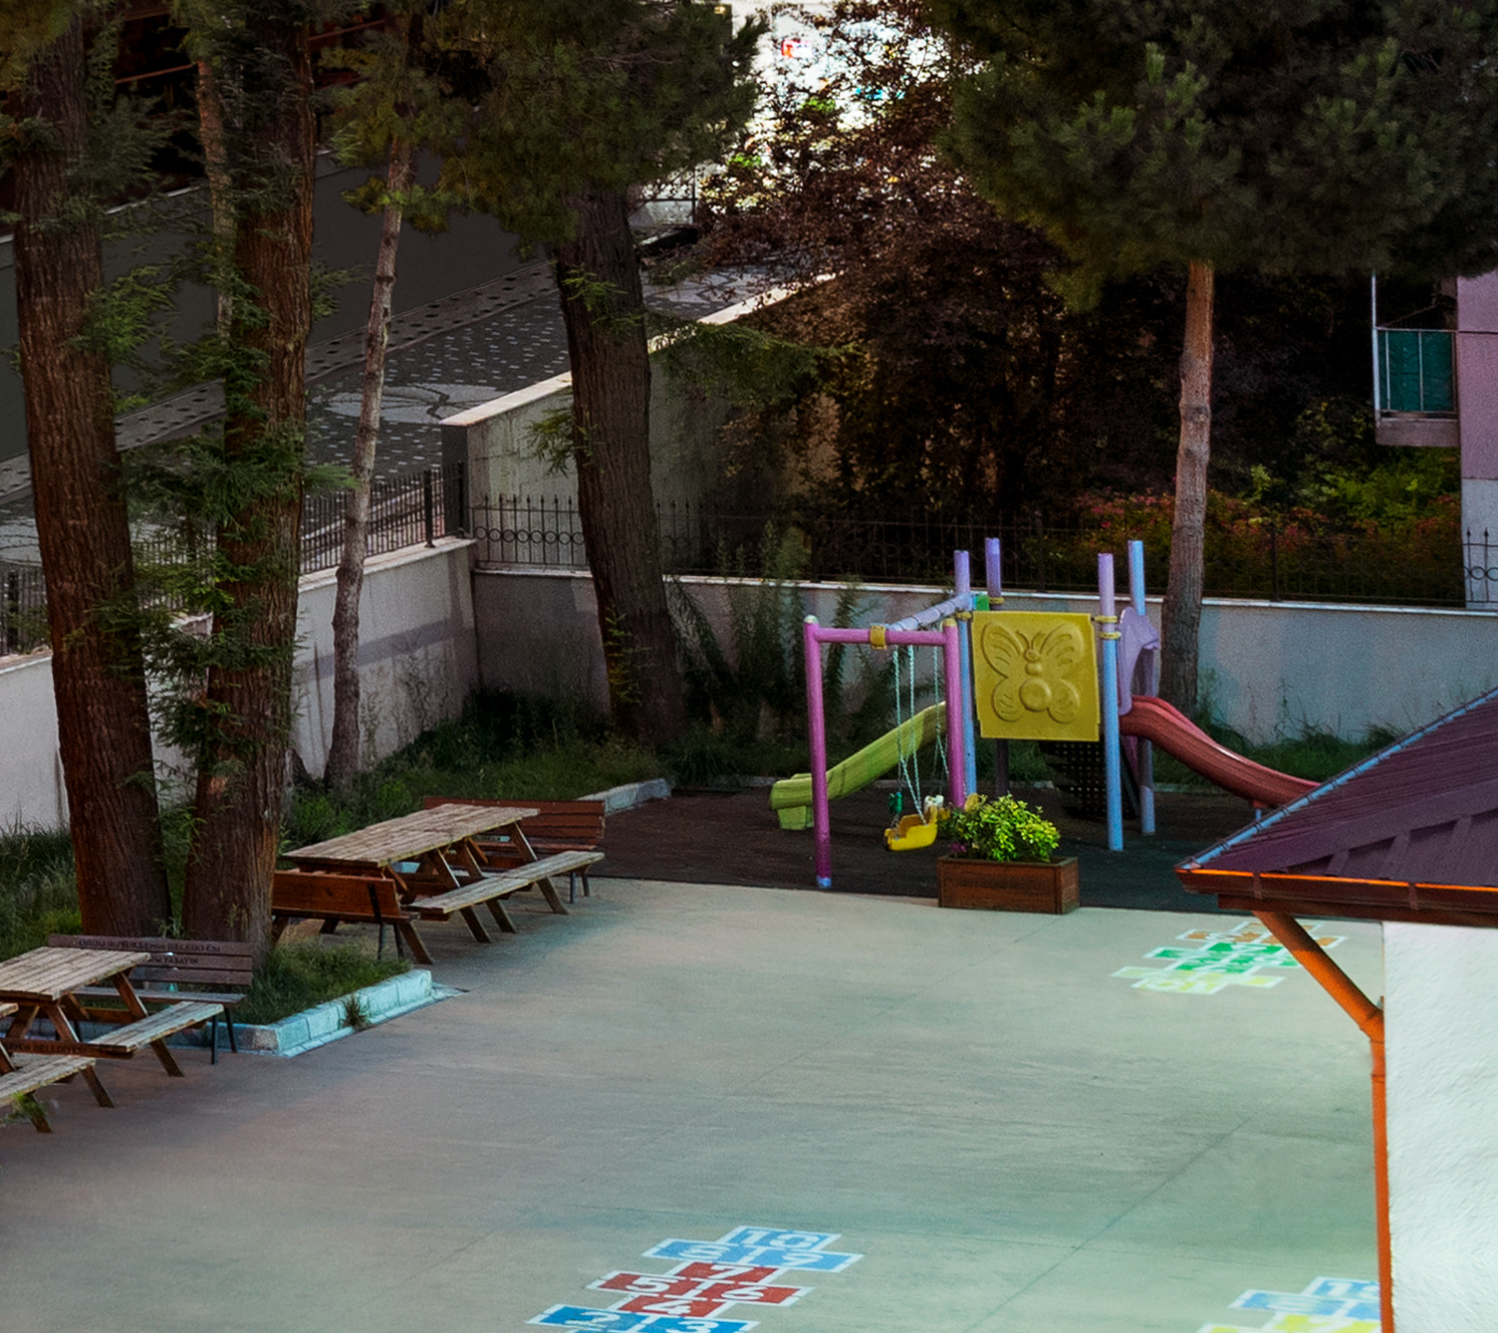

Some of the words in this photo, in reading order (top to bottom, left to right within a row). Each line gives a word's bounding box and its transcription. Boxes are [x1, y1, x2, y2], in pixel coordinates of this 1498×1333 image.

[740, 1230, 820, 1248] 10
[708, 1264, 755, 1280] 7
[625, 1276, 679, 1293] 5
[720, 1286, 768, 1301] 6
[642, 1299, 693, 1315] 4
[564, 1310, 621, 1329] 2
